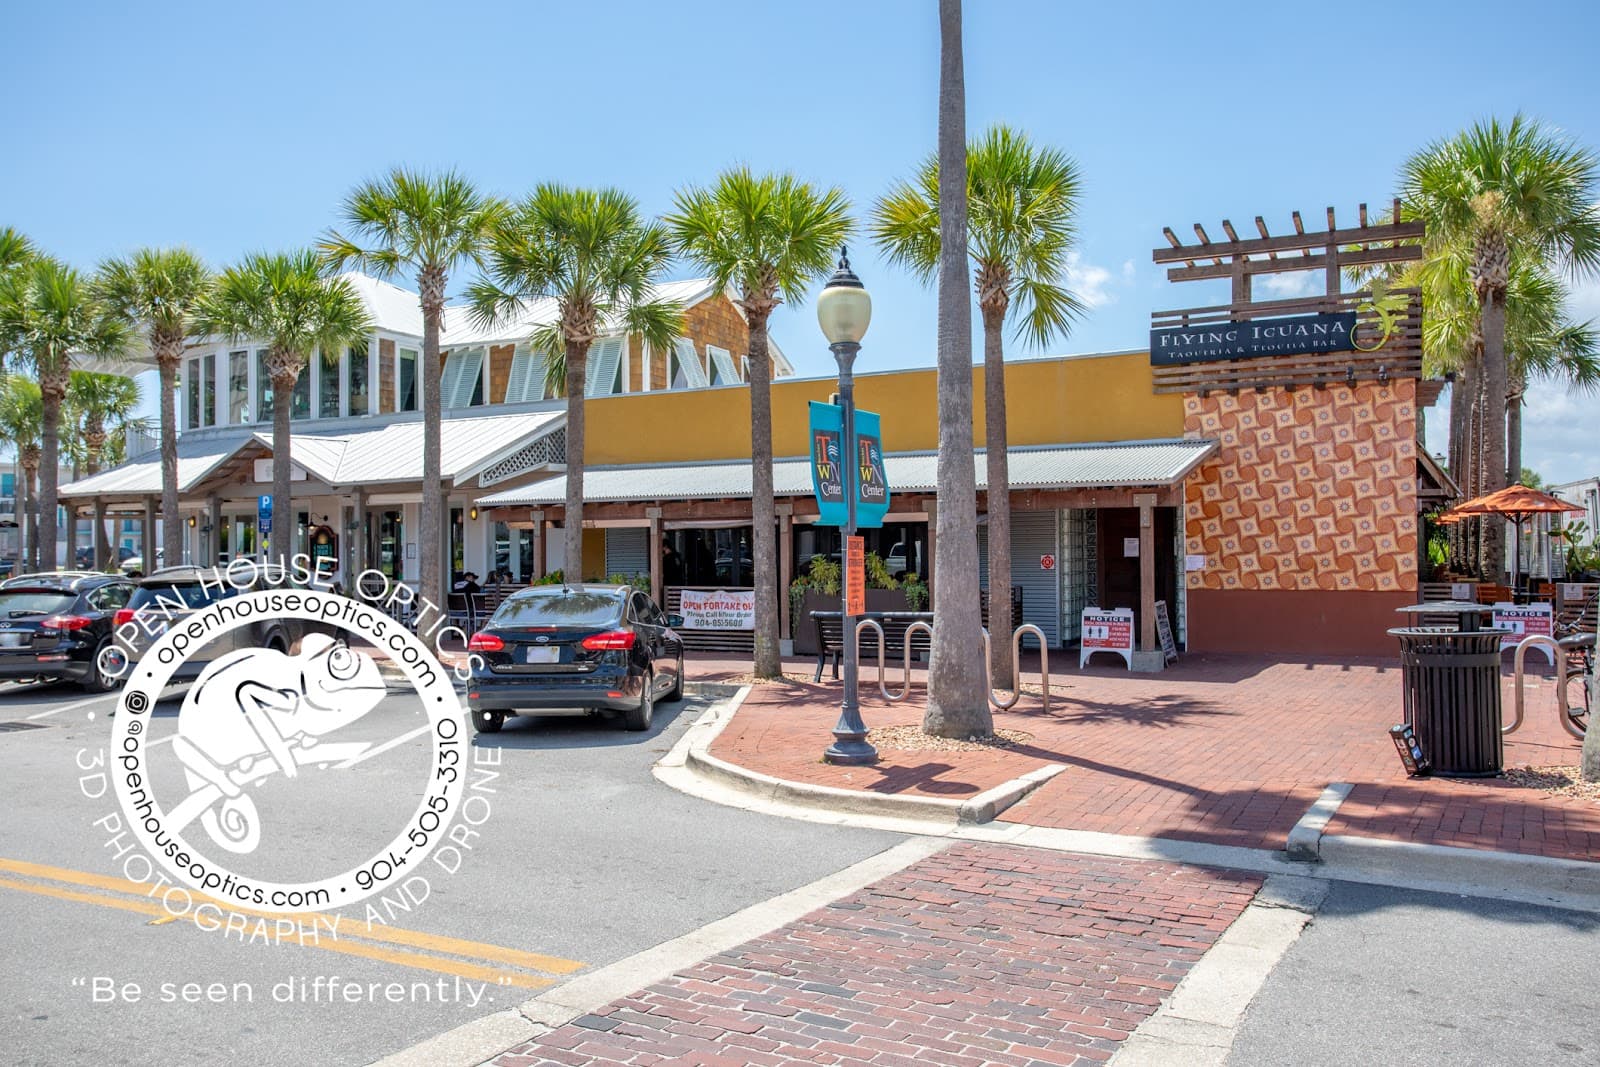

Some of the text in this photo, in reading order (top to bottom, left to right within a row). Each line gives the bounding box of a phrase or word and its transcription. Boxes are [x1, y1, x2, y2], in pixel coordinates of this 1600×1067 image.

[1160, 321, 1346, 348] FLYING IGUANA
[1167, 347, 1231, 359] TAQUERIA
[1251, 341, 1306, 352] TEQUILA
[1313, 339, 1337, 348] BAR
[821, 482, 841, 497] Center
[861, 484, 884, 498] Center
[683, 601, 702, 611] OPEN
